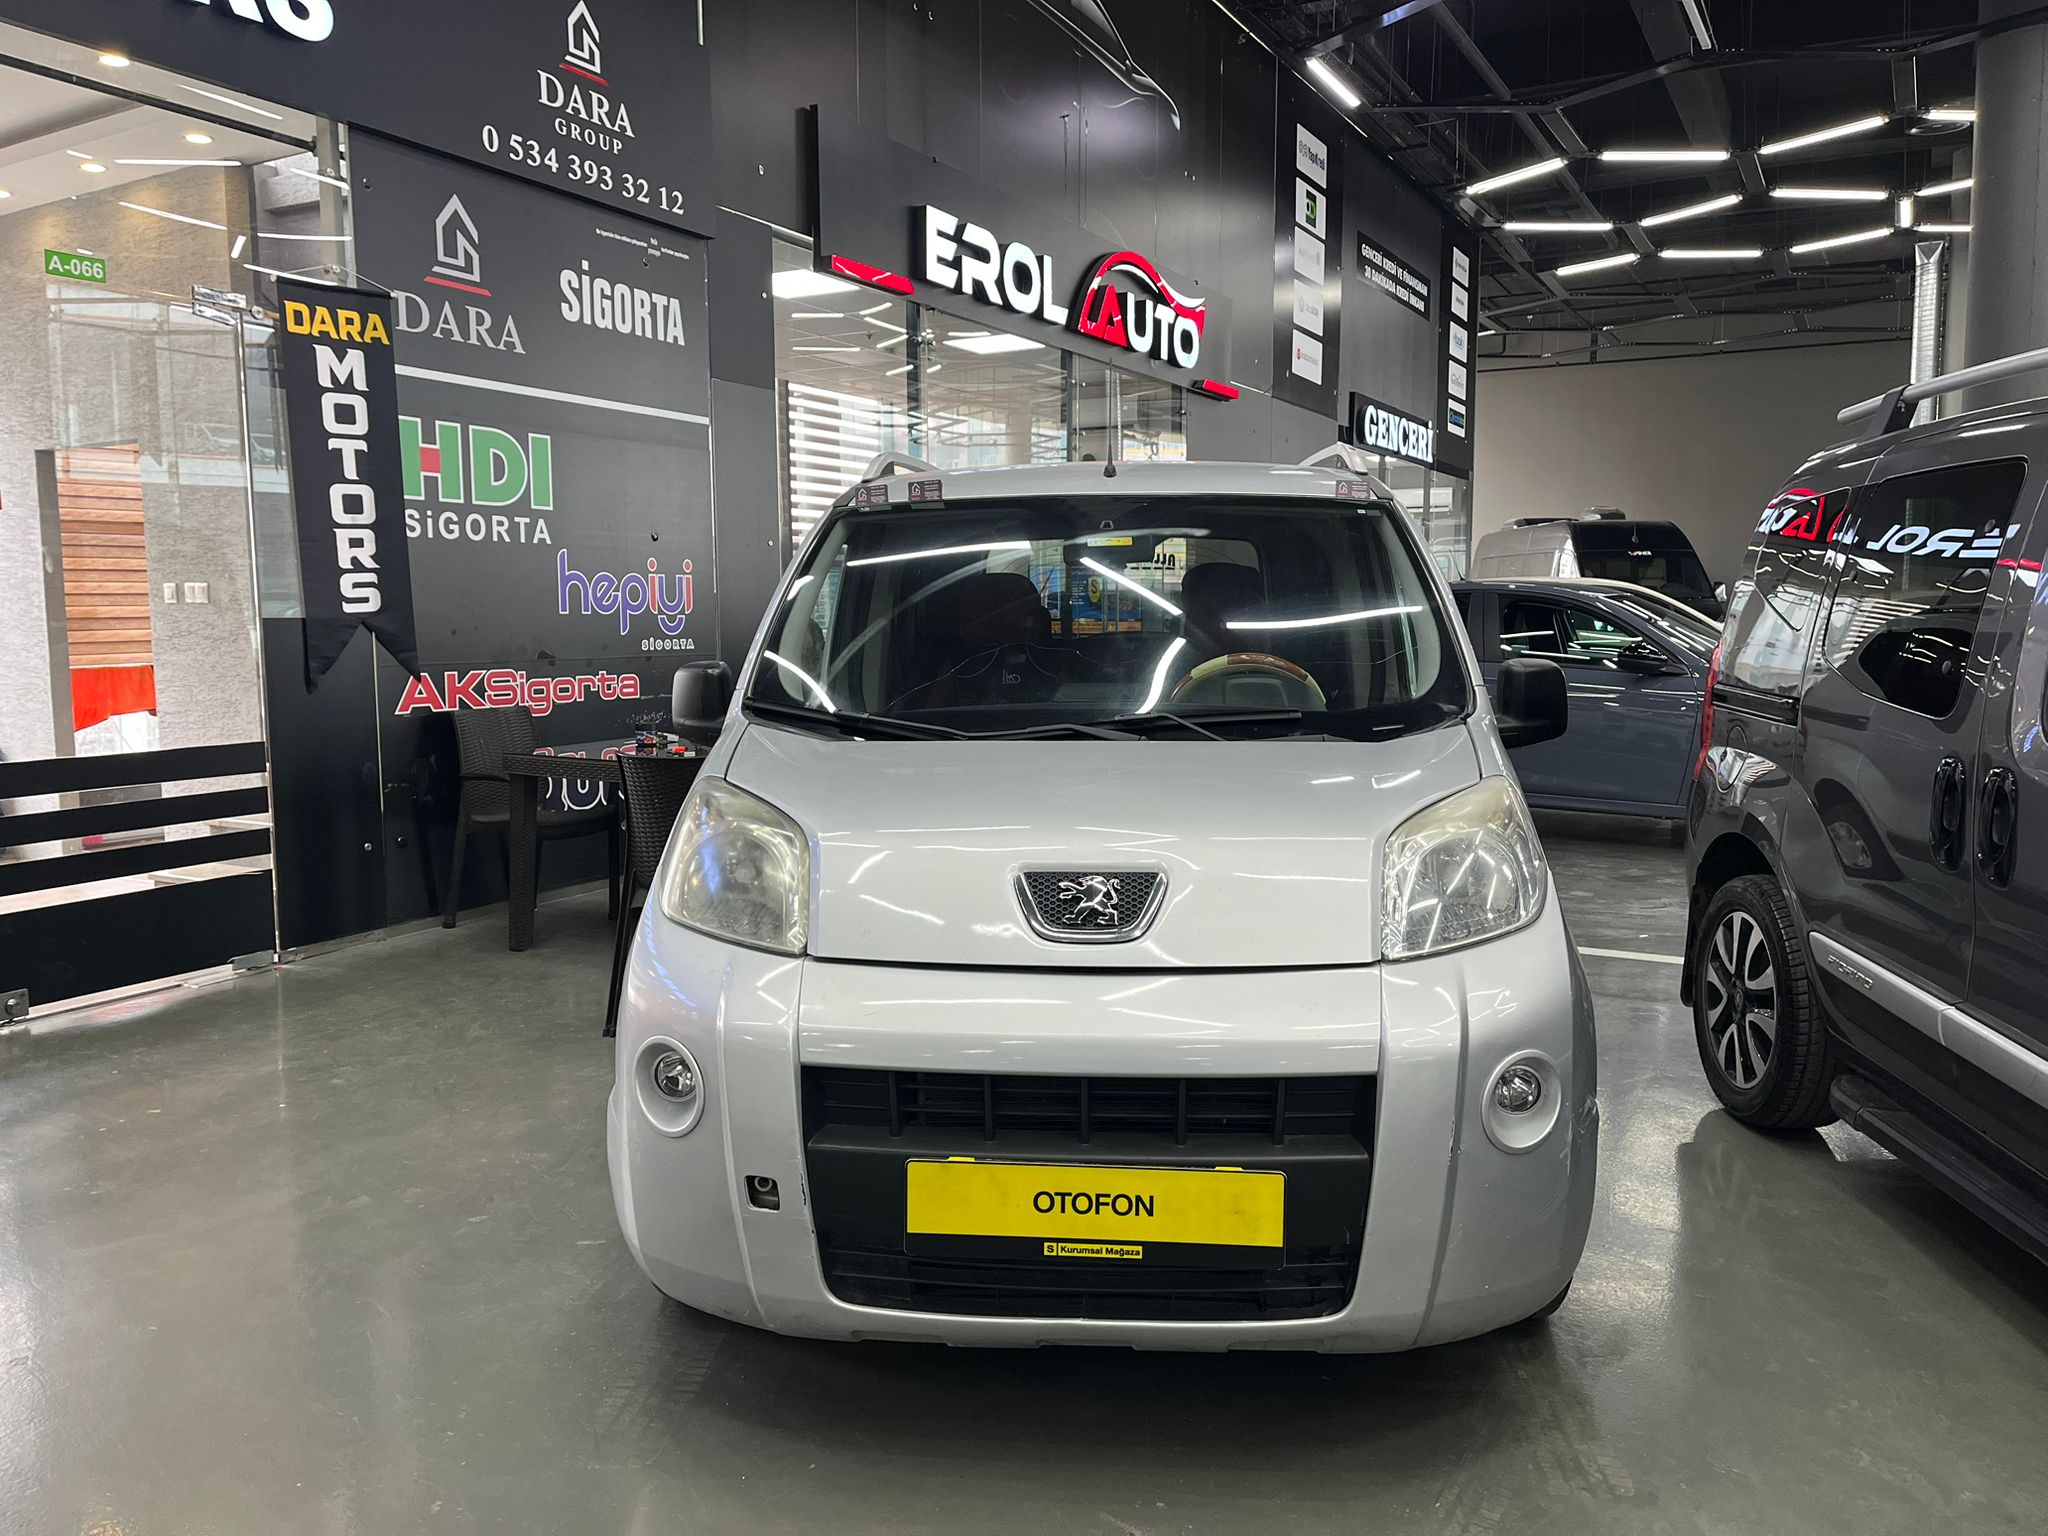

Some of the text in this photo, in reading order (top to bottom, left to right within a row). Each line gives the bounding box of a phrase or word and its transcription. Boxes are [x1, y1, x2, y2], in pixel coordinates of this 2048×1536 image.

[537, 69, 636, 138] DARA
[554, 117, 623, 154] GROUP
[481, 125, 685, 215] 0 534 393 32 12
[48, 255, 104, 278] A-066
[926, 204, 1202, 369] EROL AUTO
[283, 300, 391, 346] DARA
[395, 290, 526, 354] DARA
[560, 260, 686, 346] SİGORTA
[398, 415, 553, 510] HDI
[1364, 404, 1434, 463] GENCERİ
[312, 343, 383, 614] MOTORS
[557, 549, 693, 635] hepiyi
[394, 669, 640, 717] AKSigorta
[1033, 1190, 1155, 1217] OTOFON
[1046, 1244, 1140, 1257] S Kurumsal Mağaza
